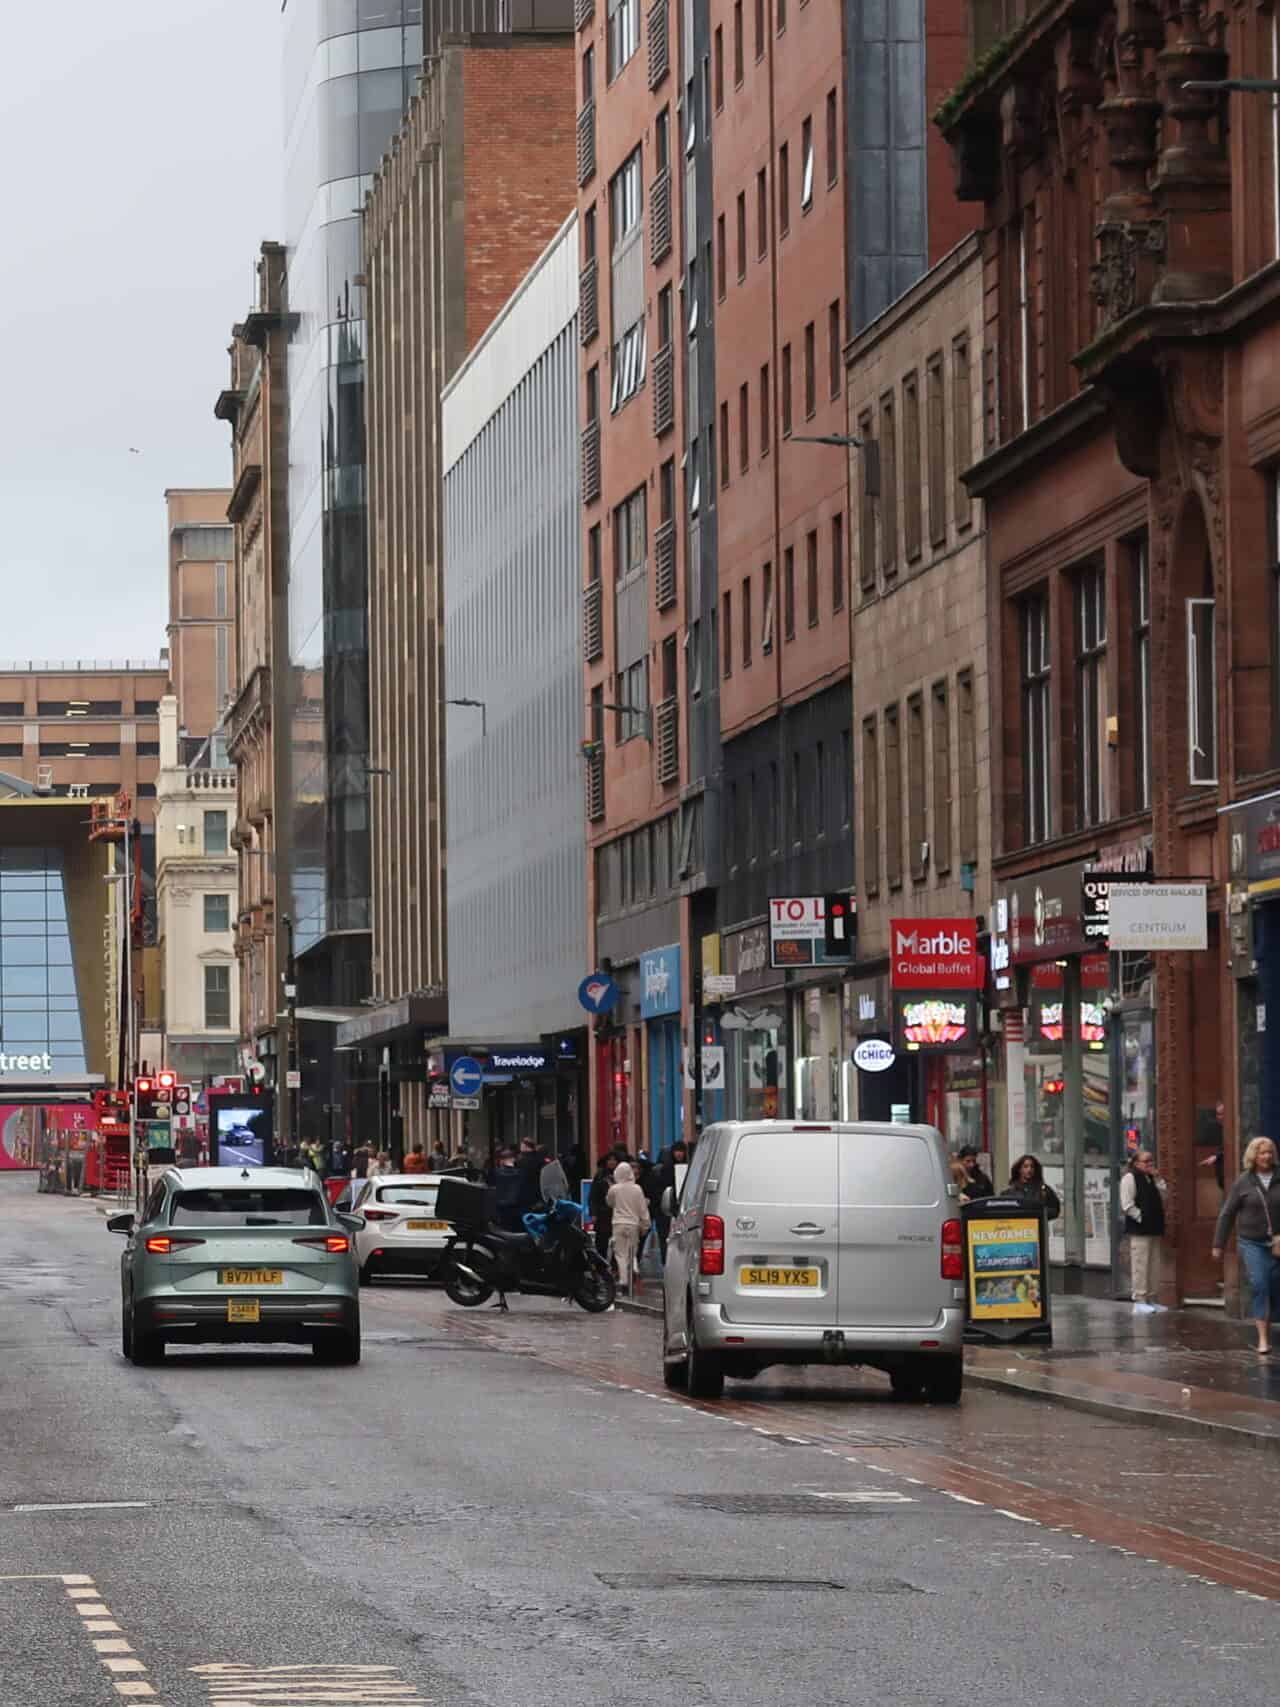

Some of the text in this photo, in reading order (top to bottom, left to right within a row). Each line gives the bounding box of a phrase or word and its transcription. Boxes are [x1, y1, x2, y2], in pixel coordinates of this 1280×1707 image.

[772, 899, 805, 921] TO
[1085, 924, 1110, 936] OPE
[1129, 922, 1187, 934] CENTRUM
[896, 929, 971, 955] Marble
[897, 961, 971, 974] Global Buffet
[493, 1055, 545, 1068] Travelodge
[227, 1271, 278, 1283] BV71 TLF
[749, 1271, 809, 1284] SL19 YXS
